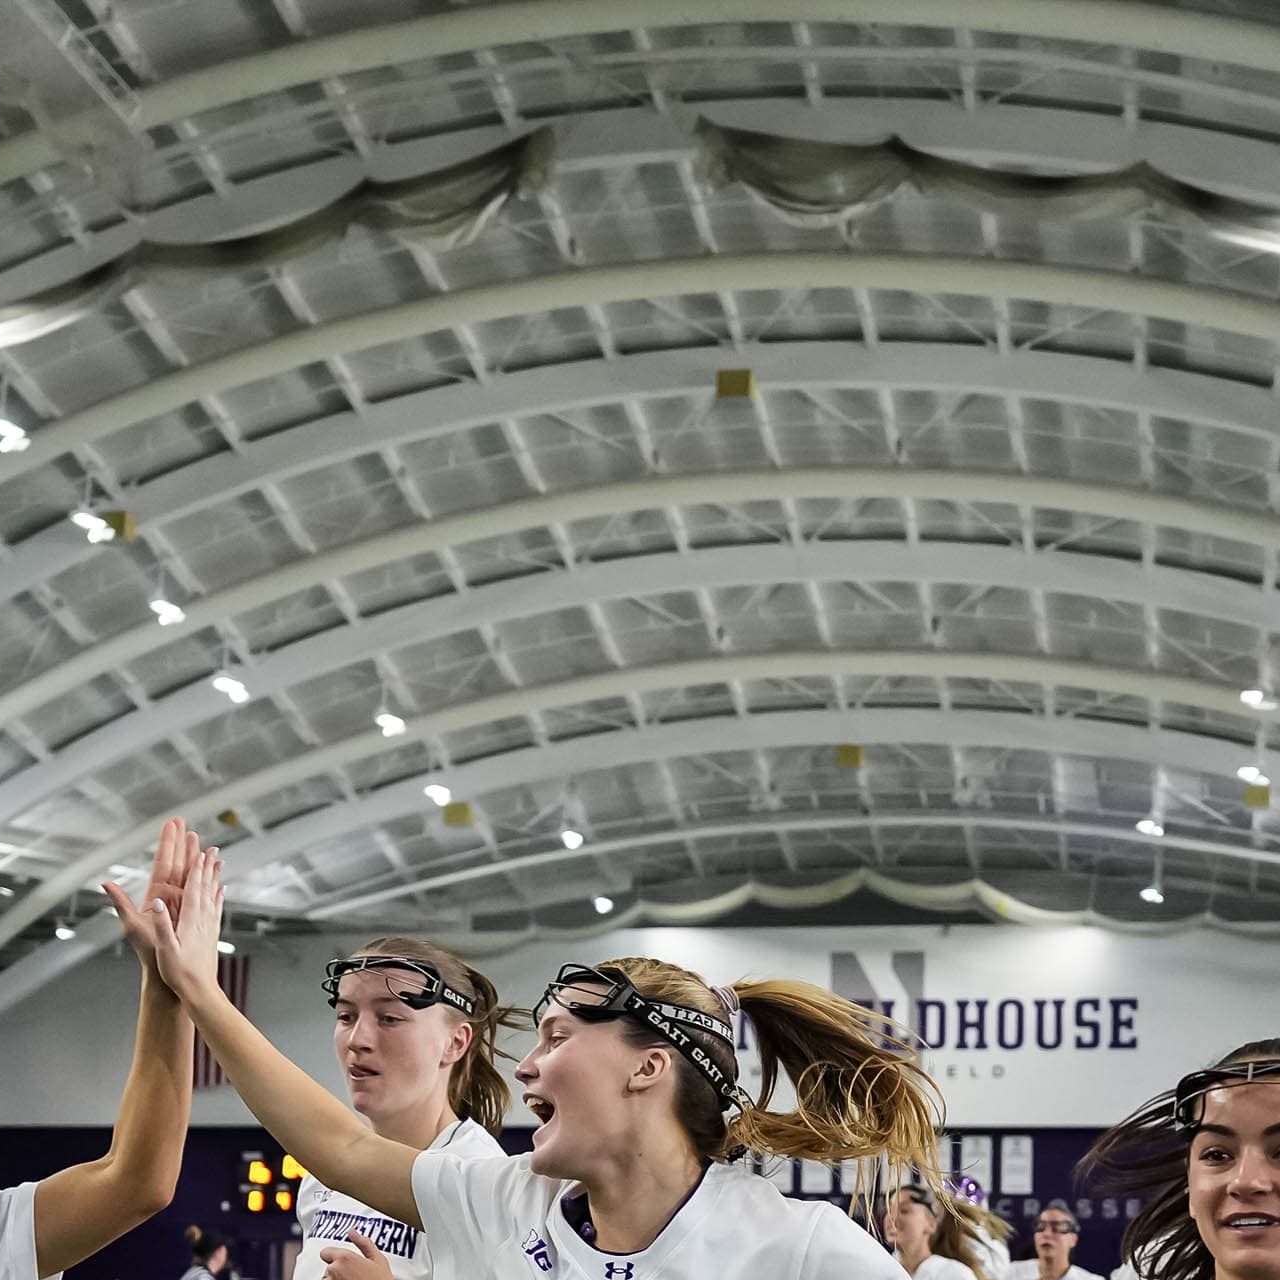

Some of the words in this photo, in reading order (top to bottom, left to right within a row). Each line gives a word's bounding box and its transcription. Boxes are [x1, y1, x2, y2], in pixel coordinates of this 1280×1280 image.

[443, 988, 465, 1007] GAIT
[647, 1011, 690, 1046] GAIT
[691, 1048, 723, 1082] GAIT
[851, 999, 1138, 1050] LDHOUSE
